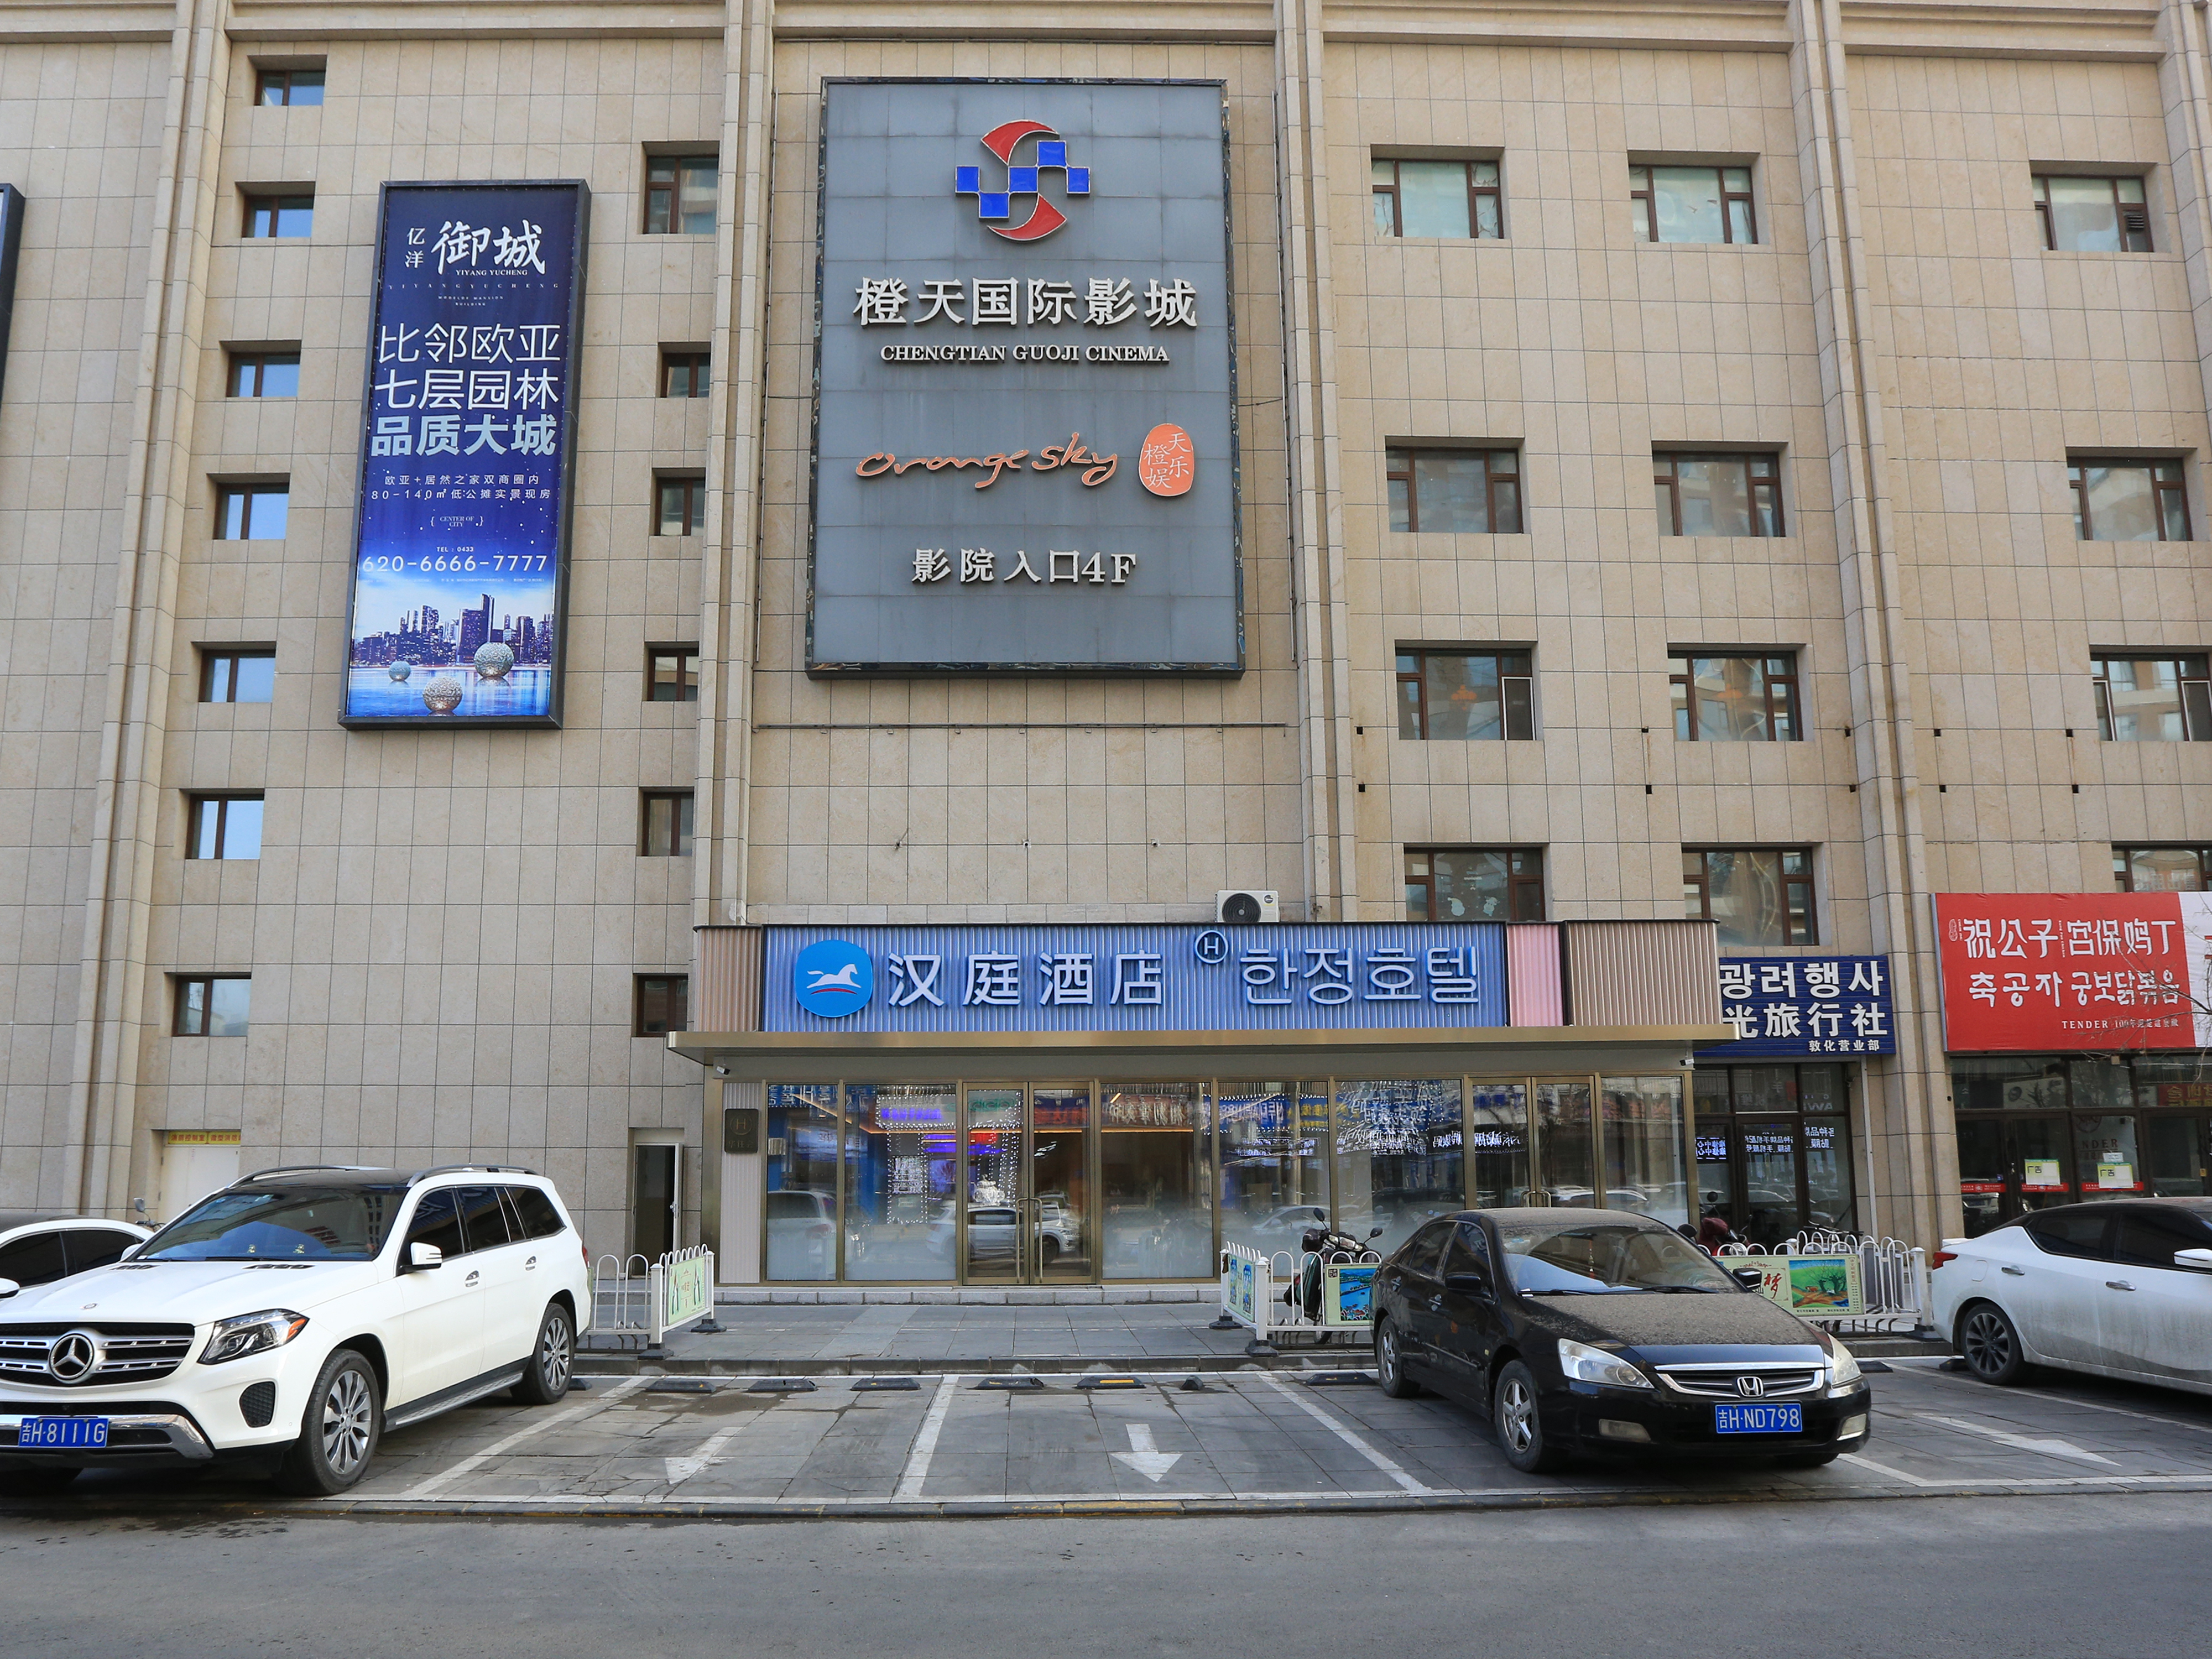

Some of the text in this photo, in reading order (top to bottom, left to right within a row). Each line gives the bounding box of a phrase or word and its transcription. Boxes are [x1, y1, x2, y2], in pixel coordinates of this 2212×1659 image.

[405, 228, 425, 268] 亿洋
[431, 220, 545, 274] 御城
[853, 276, 1197, 328] 橙天国际影城
[379, 323, 560, 364] 比邻欧亚
[880, 345, 1170, 362] CHENGTIAN GUOJI CINEMA
[375, 368, 559, 410] 七层园林
[371, 414, 557, 456] 品质大城
[362, 555, 547, 572] 620-6666-7777
[888, 950, 1162, 1007] 汉庭酒店
[1240, 945, 1478, 1005] 한정호텔
[1969, 971, 2063, 1008] 축공자
[1722, 1002, 1887, 1038] 光旅行社
[2062, 1020, 2108, 1029] TENDER
[1808, 1040, 1880, 1052] 敦化营业部
[22, 1419, 106, 1444] 吉H·8111G
[1718, 1408, 1800, 1428] 吉H·ND798
